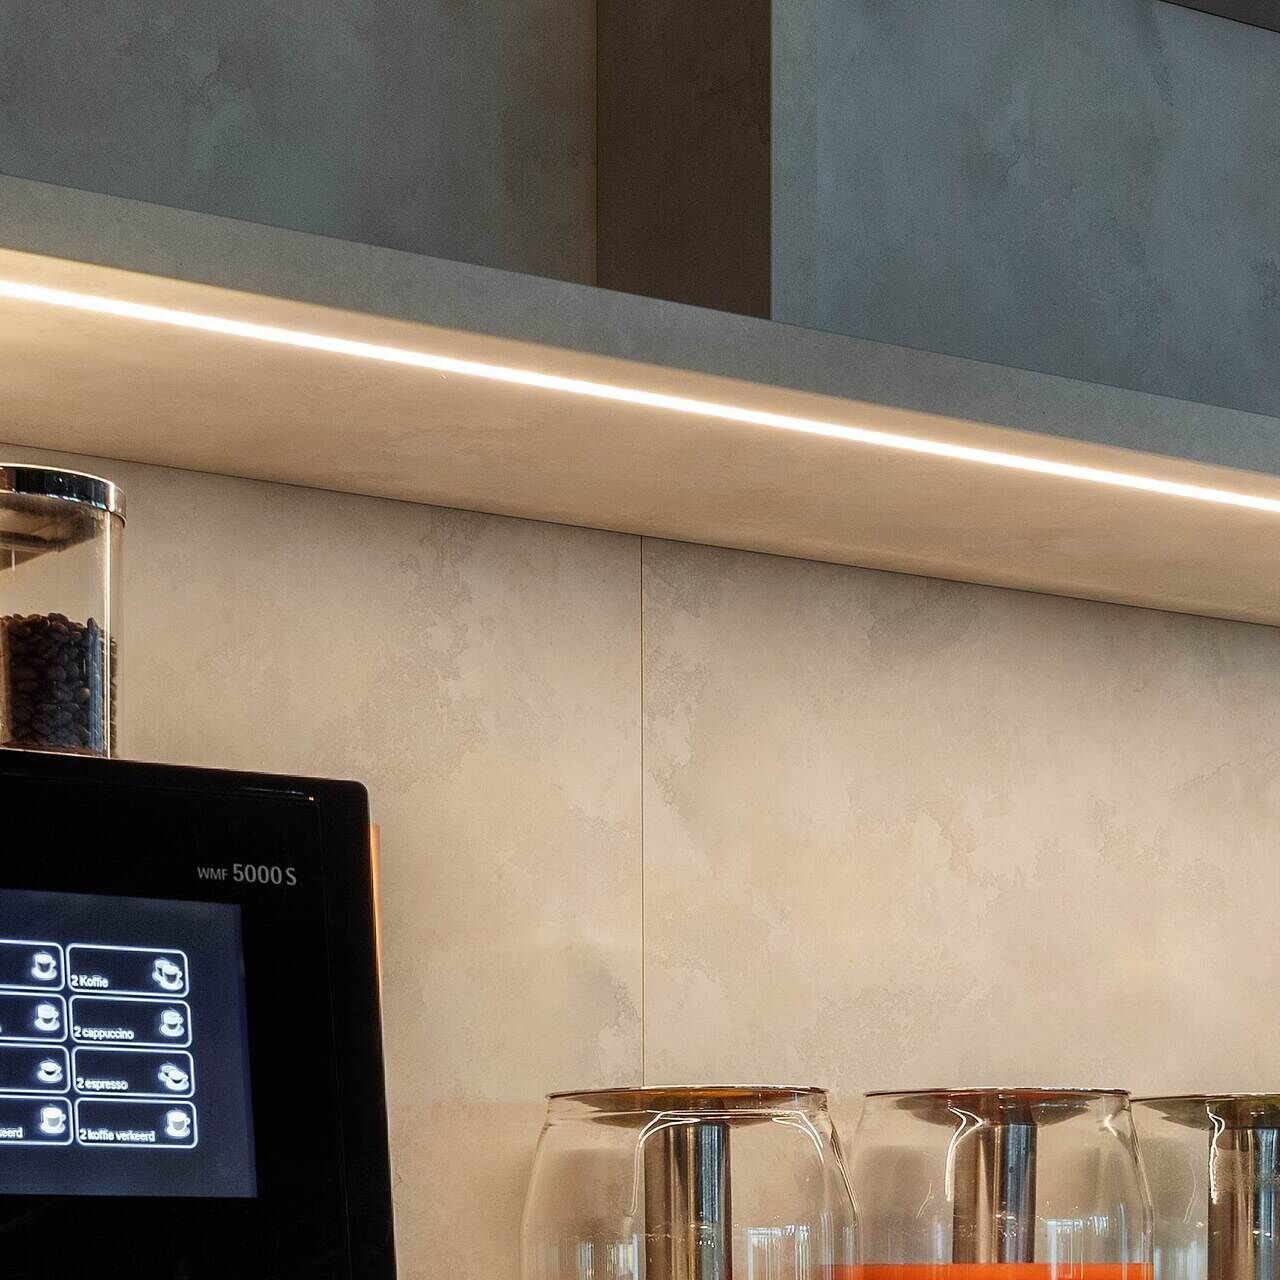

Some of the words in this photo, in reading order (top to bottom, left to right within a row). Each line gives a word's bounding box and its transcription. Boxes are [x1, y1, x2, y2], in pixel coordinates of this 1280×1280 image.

[197, 866, 229, 881] WMF
[71, 974, 79, 987] 2
[79, 975, 109, 988] Koffie
[73, 1025, 81, 1038] 2
[82, 1028, 135, 1041] cappuccino
[76, 1077, 84, 1089] 2
[84, 1079, 129, 1091] espresso
[80, 1128, 87, 1140] 2
[87, 1128, 115, 1141] koffie
[115, 1130, 156, 1142] verkeerd
